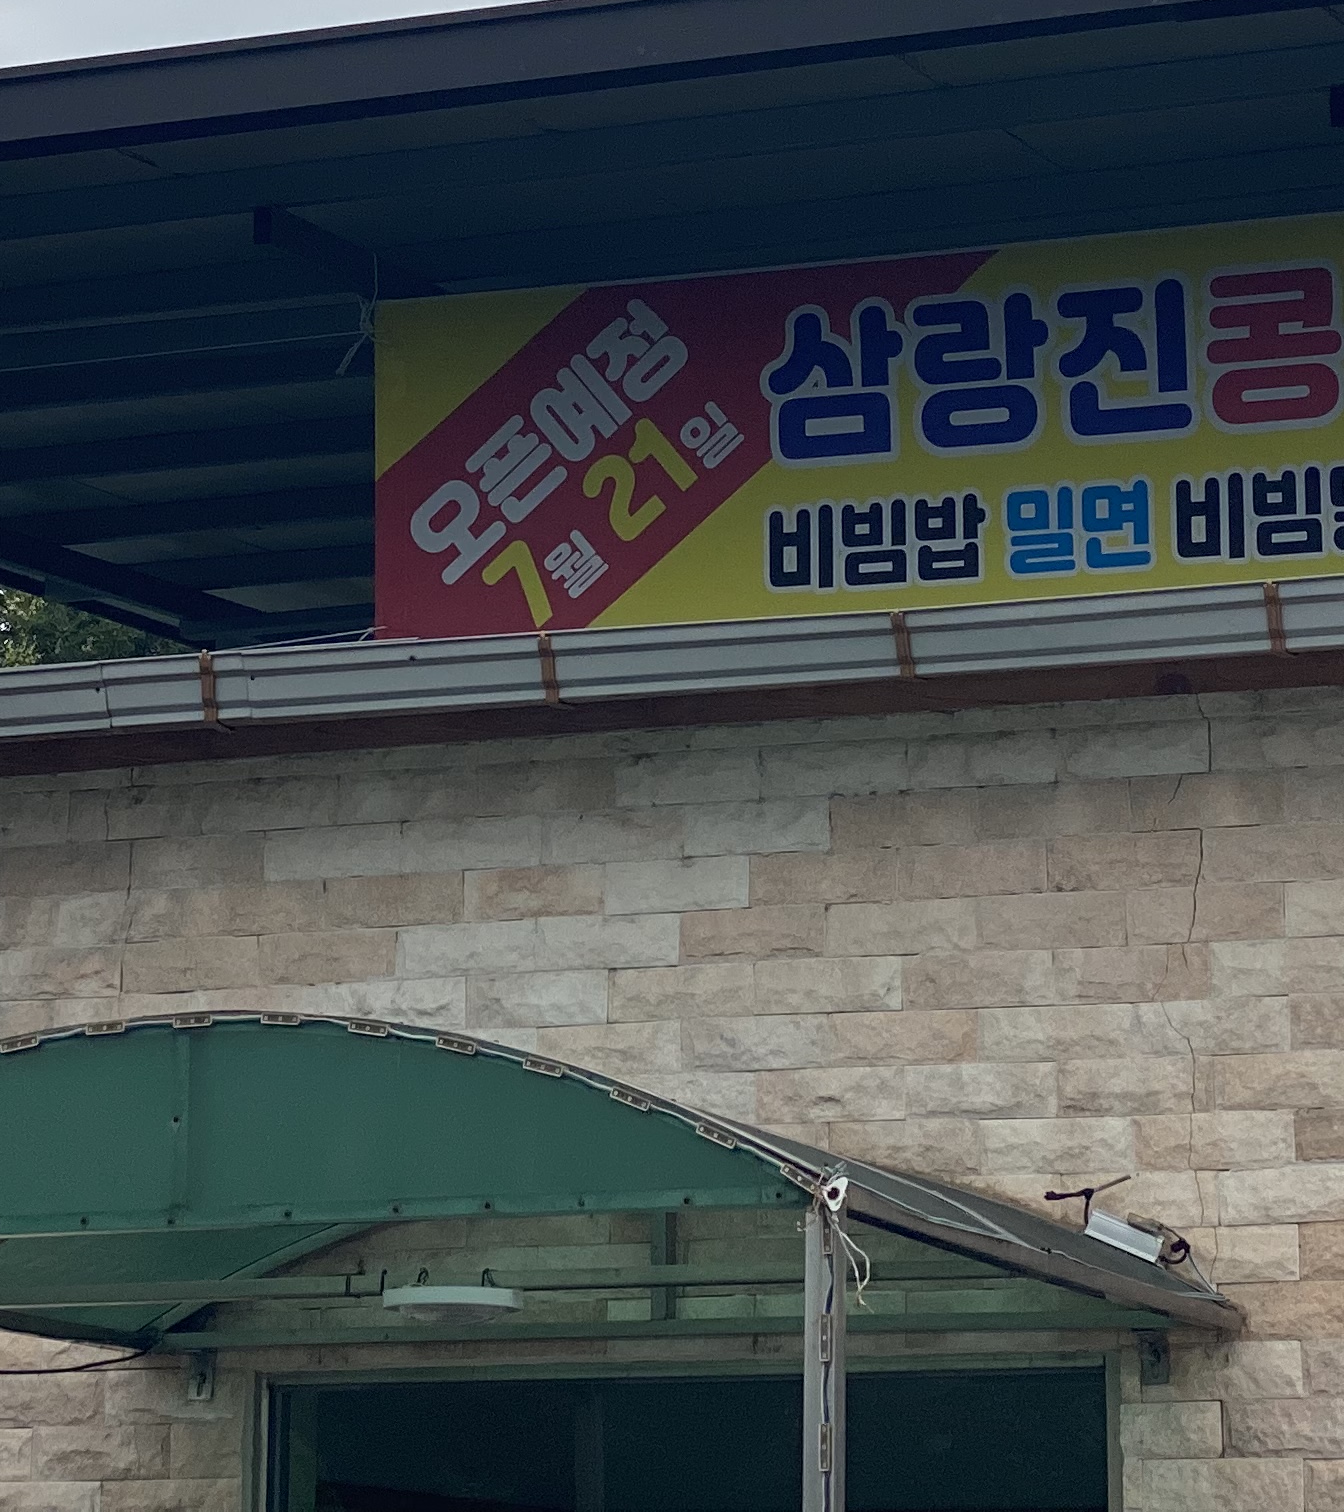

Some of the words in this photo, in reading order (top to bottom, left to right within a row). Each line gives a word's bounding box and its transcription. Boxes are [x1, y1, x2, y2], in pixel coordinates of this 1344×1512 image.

[409, 298, 689, 586] 오픈예정
[481, 528, 610, 630] 7월
[582, 400, 745, 542] 21일
[768, 493, 987, 589] 비빔밥
[1006, 479, 1152, 575] 밀면
